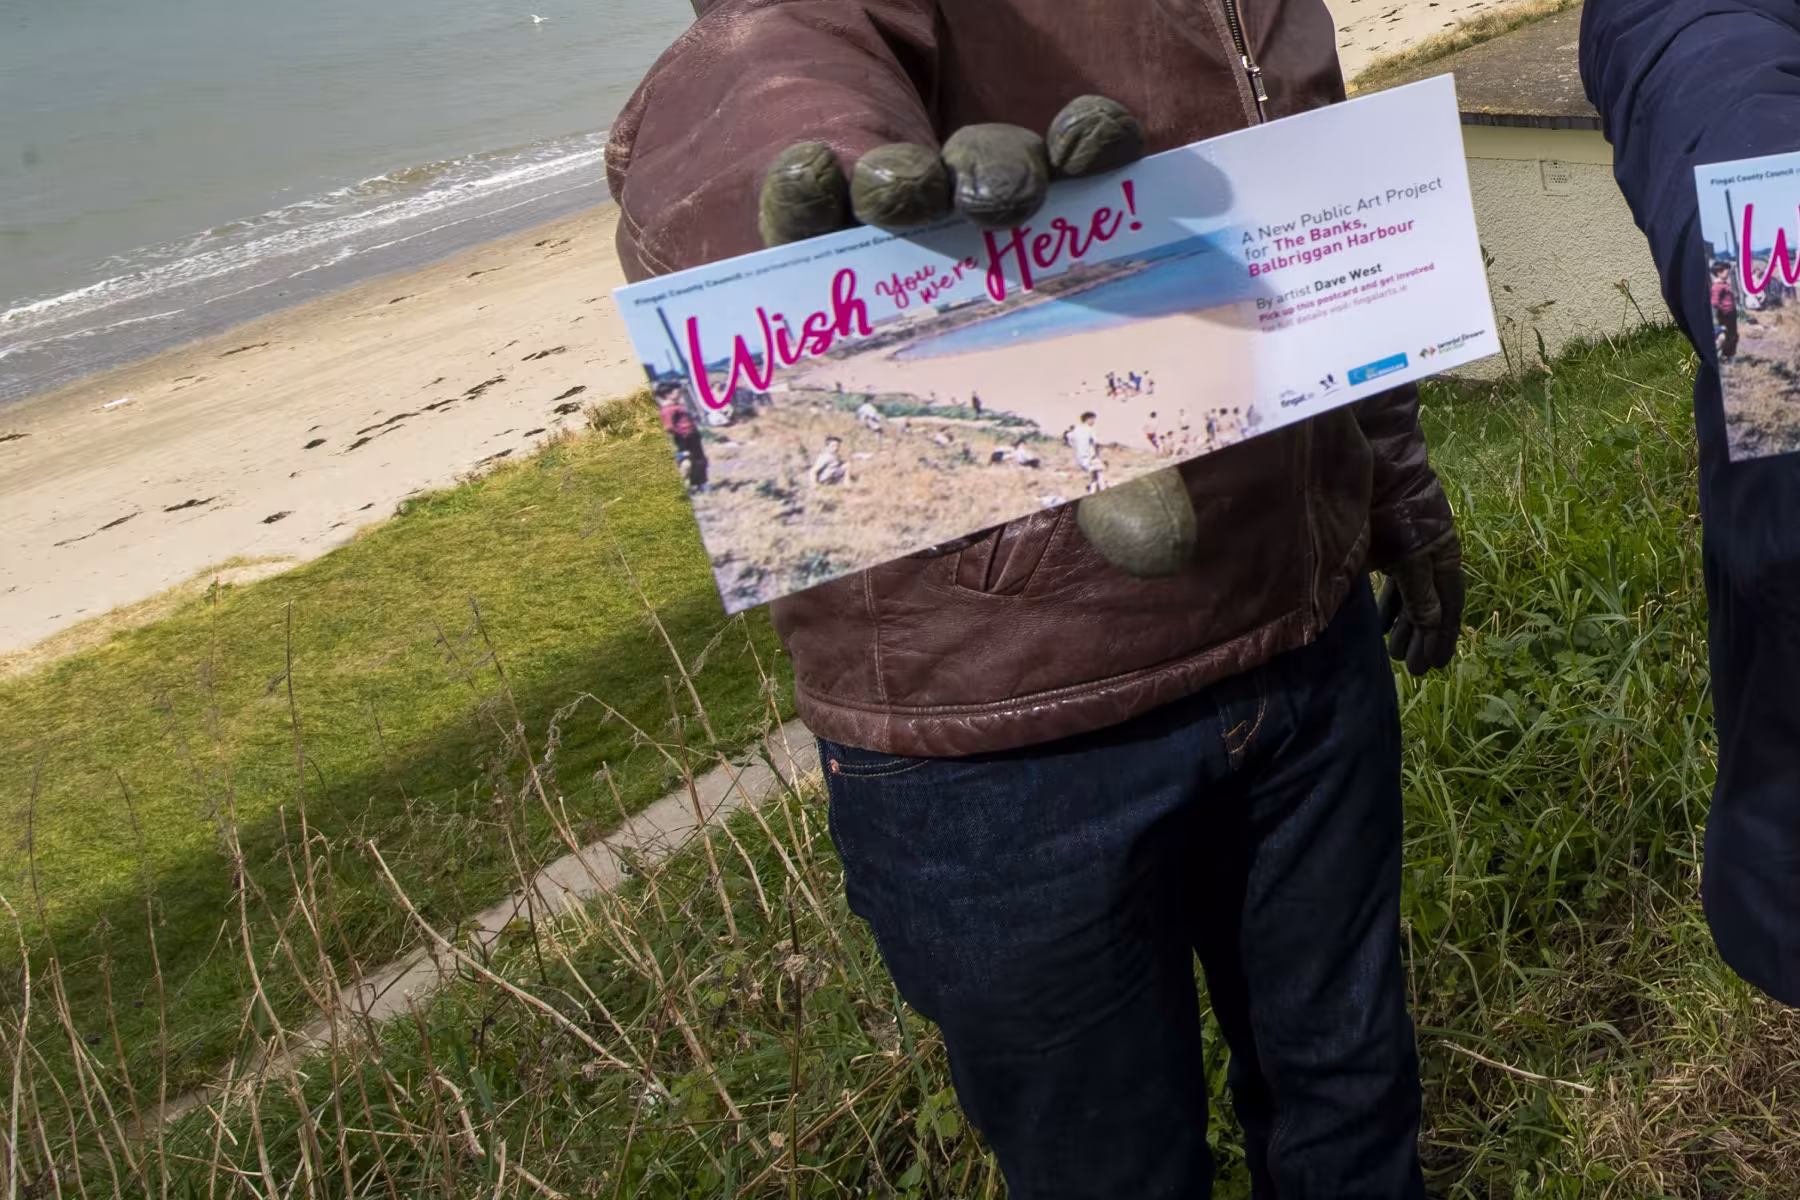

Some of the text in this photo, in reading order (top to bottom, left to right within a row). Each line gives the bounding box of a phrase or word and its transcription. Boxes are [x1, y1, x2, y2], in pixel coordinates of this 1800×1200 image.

[1710, 176, 1735, 187] Fingal
[1737, 172, 1764, 183] County
[1765, 168, 1794, 179] Council
[1242, 177, 1443, 245] A New Public Art Project
[1244, 217, 1368, 261] for The Banks,
[1248, 218, 1415, 278] Balbriggan Harbour
[686, 268, 873, 410] Wish
[874, 265, 936, 309] You
[982, 180, 1143, 302] Here!
[1256, 263, 1383, 312] By artist Dave West
[1258, 311, 1280, 324] Pick
[1296, 300, 1315, 311] this
[1317, 287, 1358, 308] postcard
[1360, 280, 1378, 292] and
[1380, 274, 1395, 288] get
[1396, 262, 1435, 281] involved
